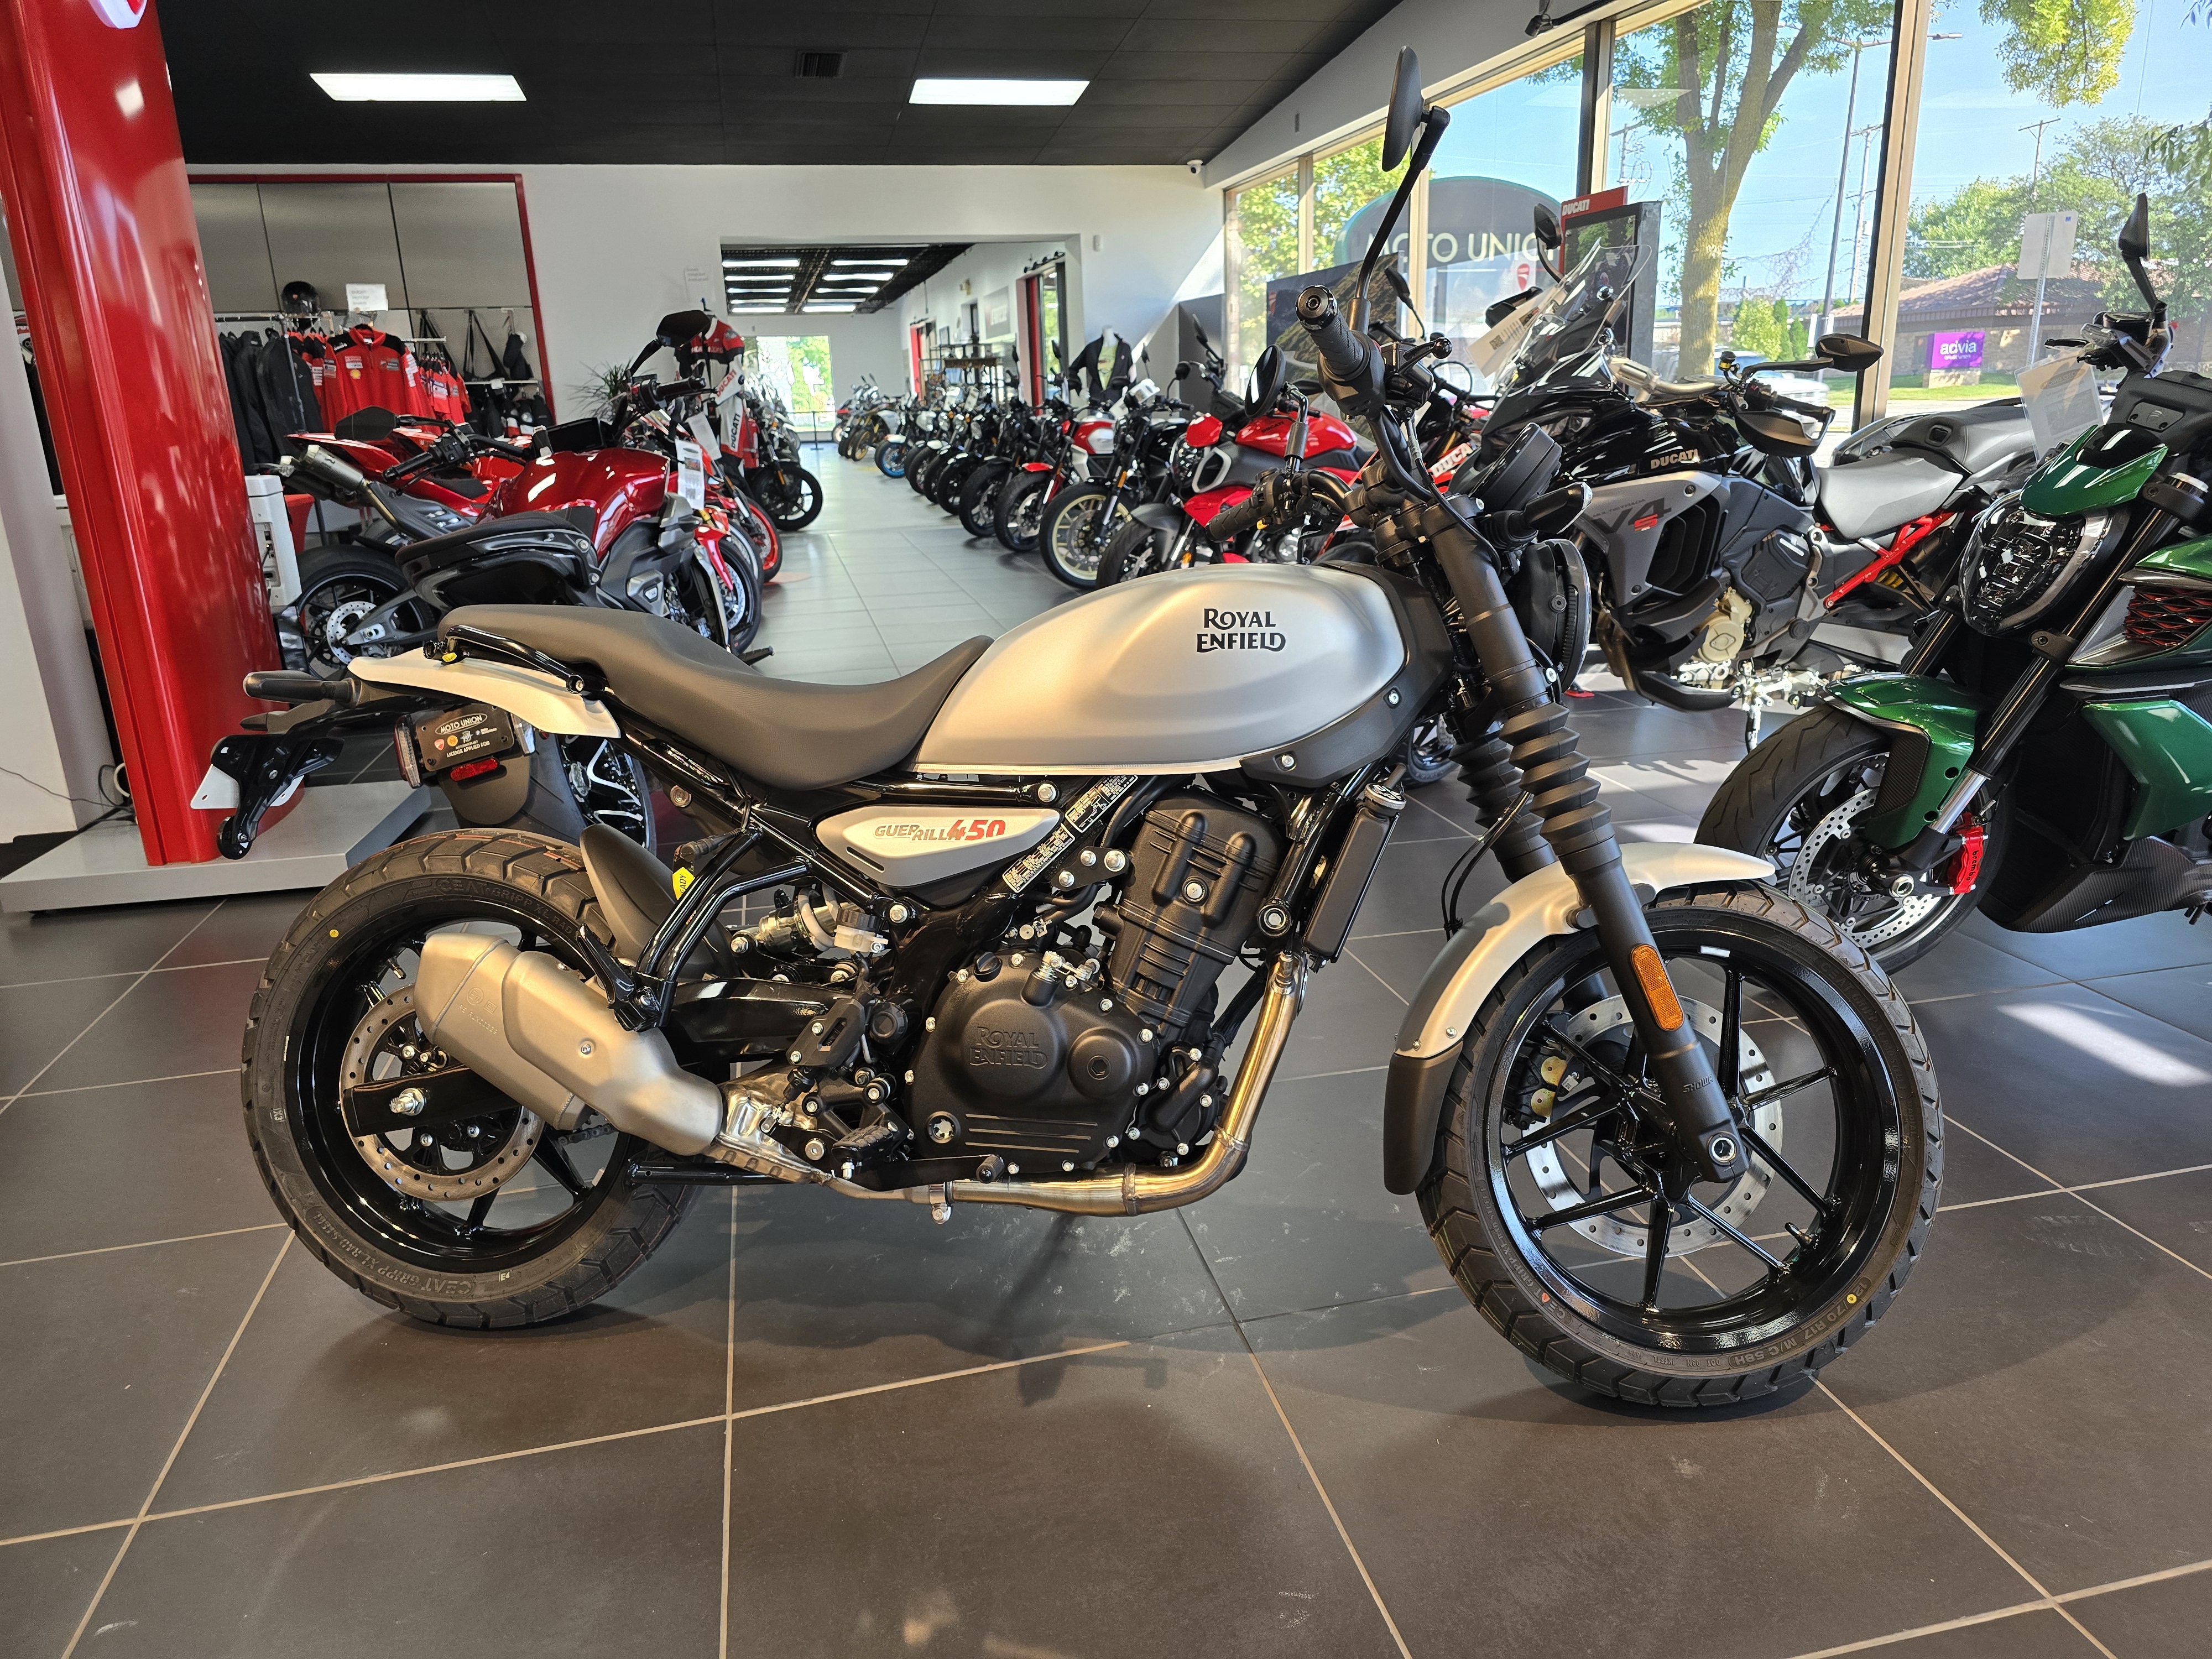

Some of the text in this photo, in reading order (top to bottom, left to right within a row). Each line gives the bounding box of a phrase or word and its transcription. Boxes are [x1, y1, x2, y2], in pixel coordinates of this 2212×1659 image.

[1562, 199, 1590, 216] DUCATI
[1361, 232, 1561, 263] MO UNIO
[1939, 340, 1976, 355] advia
[716, 369, 737, 398] DUCATI
[731, 413, 742, 449] DUCATI
[1651, 448, 1699, 469] DUCATI
[1203, 608, 1276, 630] ROYAL
[1197, 632, 1286, 653] ENFIELD
[440, 714, 483, 733] MOTO UNION
[946, 819, 1006, 841] 450
[1966, 850, 1979, 881] brembo
[976, 1026, 1040, 1048] ROYAL
[970, 1047, 1048, 1070] ENFIELD
[1683, 1073, 1714, 1093] SHOWA
[1533, 1288, 1566, 1319] CET
[1734, 1282, 1868, 1365] 12/70 R17 M/C 58H
[1707, 1358, 1721, 1367] DOT
